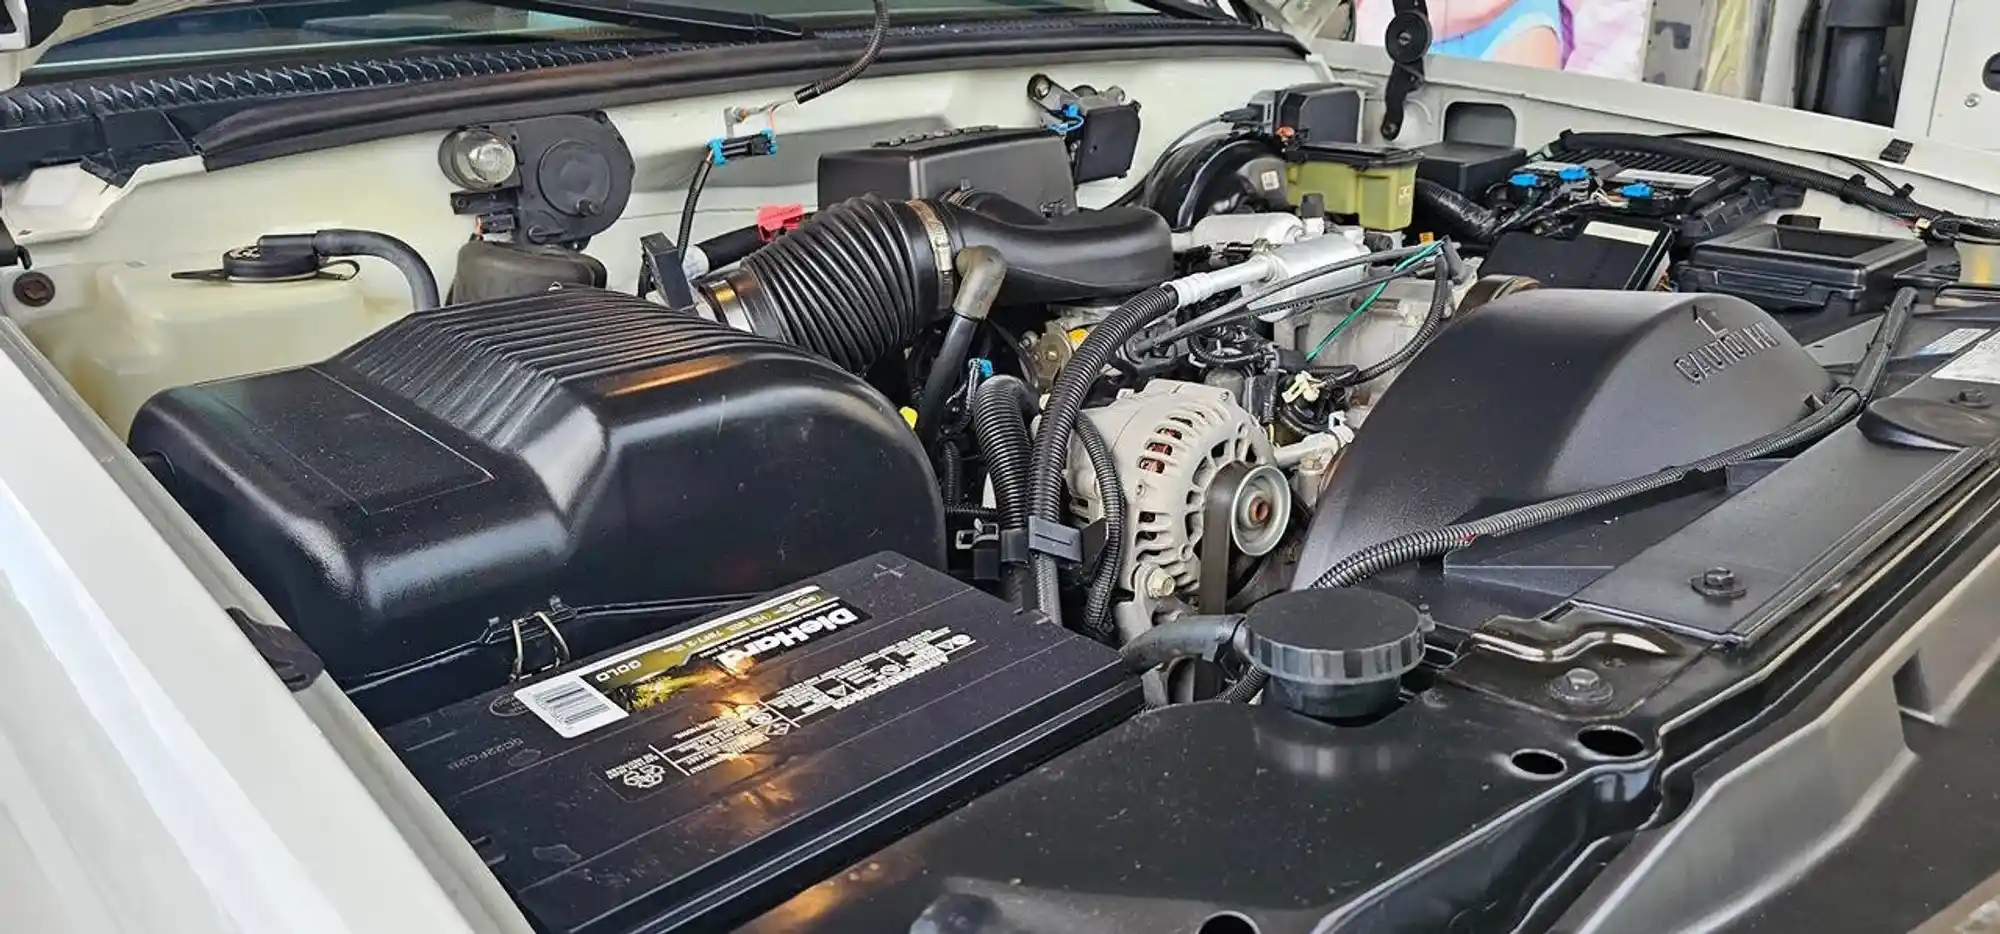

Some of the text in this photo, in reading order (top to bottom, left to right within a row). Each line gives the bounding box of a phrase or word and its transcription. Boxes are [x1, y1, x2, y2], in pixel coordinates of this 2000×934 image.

[1674, 330, 1756, 383] CAUTION
[711, 608, 858, 673] DieHard
[596, 660, 641, 682] GOLD
